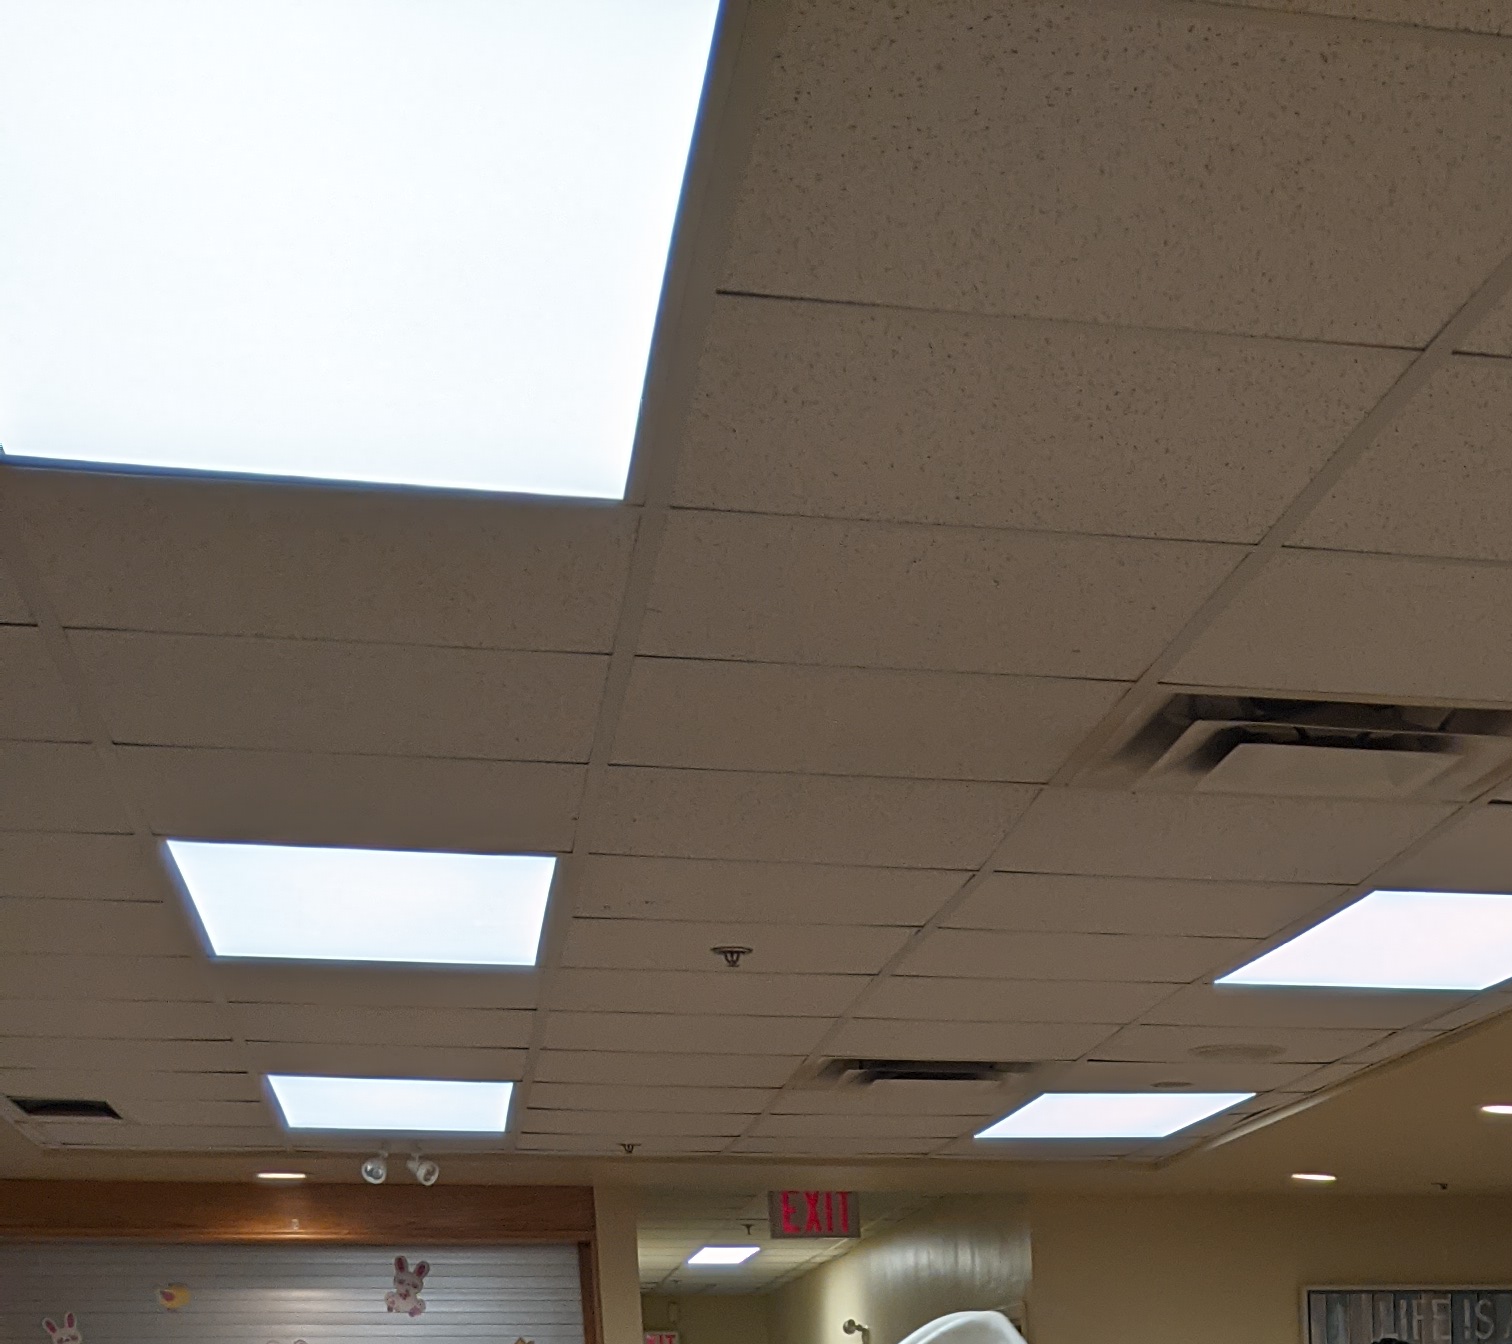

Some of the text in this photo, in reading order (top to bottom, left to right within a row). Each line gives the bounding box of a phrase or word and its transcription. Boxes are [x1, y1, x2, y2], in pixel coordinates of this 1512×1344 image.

[780, 1190, 850, 1234] EXIT
[1378, 1298, 1450, 1341] LIFE
[1463, 1299, 1495, 1340] IS
